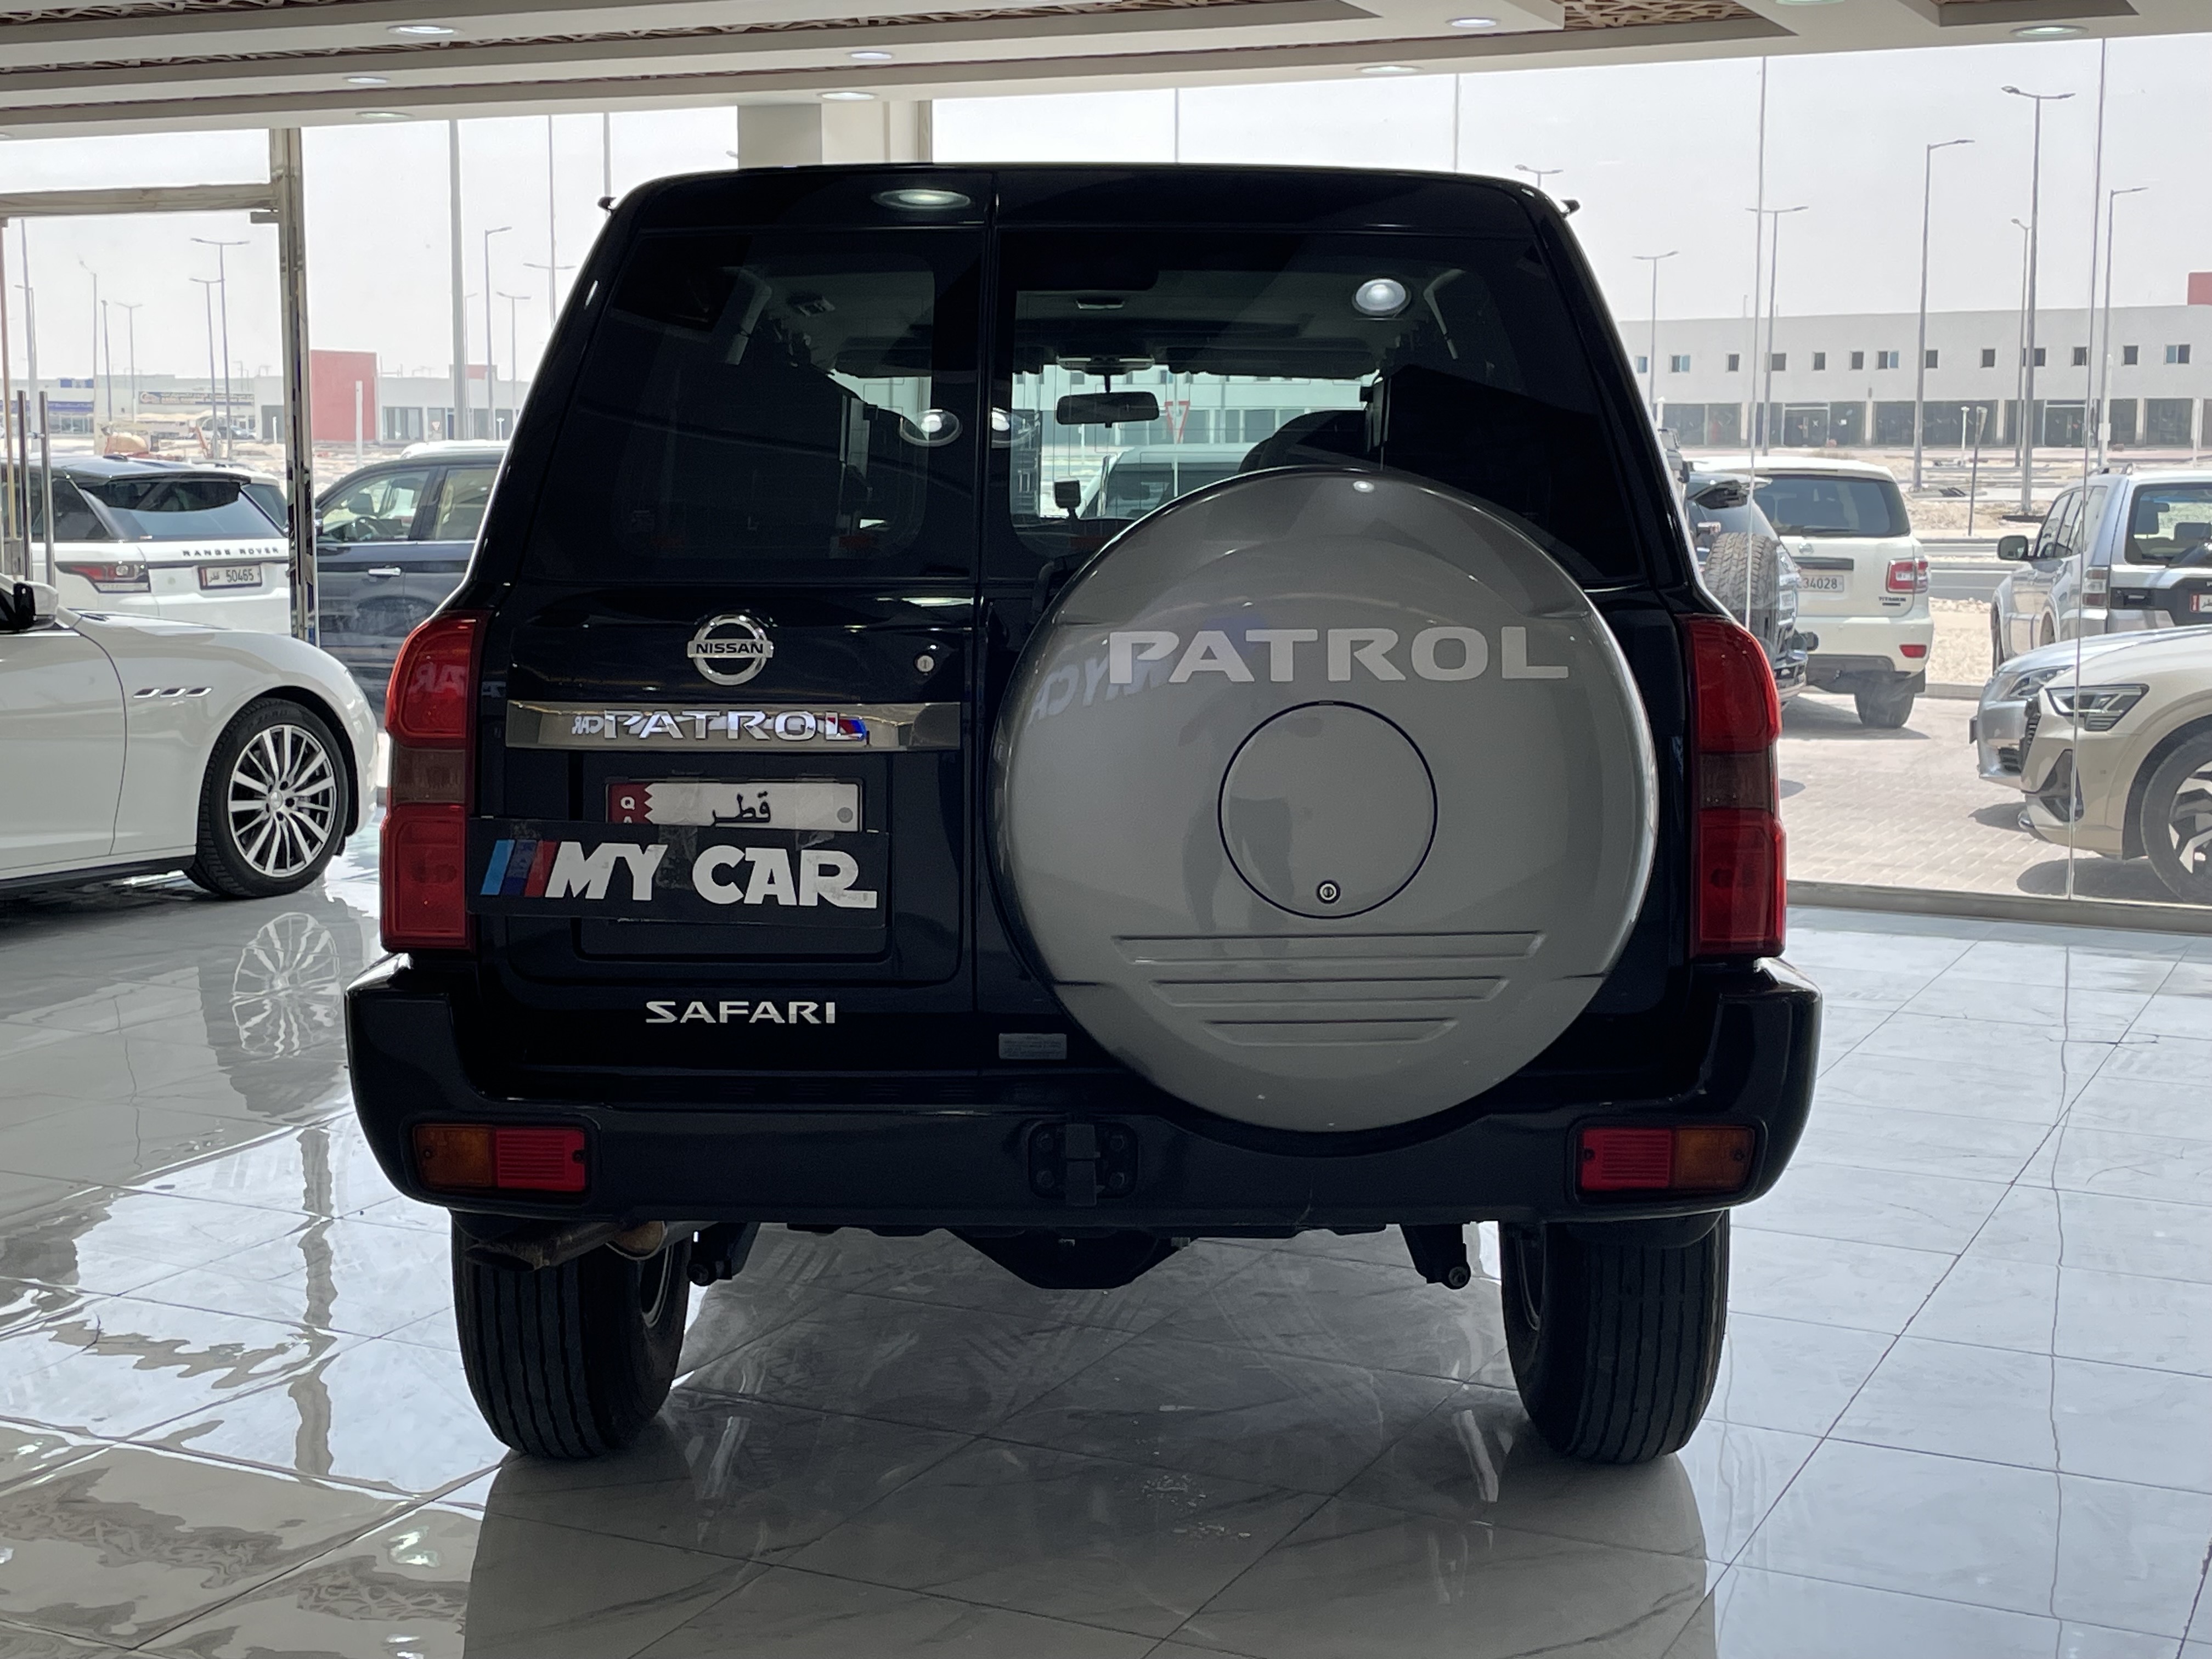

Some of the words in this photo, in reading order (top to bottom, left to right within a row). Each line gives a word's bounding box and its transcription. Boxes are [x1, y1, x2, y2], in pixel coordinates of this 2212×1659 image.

[226, 569, 255, 583] 50465
[1797, 577, 1837, 589] 34028
[696, 643, 763, 654] NISSAN
[1108, 627, 1568, 684] PATROL
[604, 710, 866, 740] PATROL
[712, 791, 771, 826] قطر
[545, 841, 667, 900] MY
[692, 845, 877, 909] CAR
[646, 1001, 836, 1024] SAFARI
